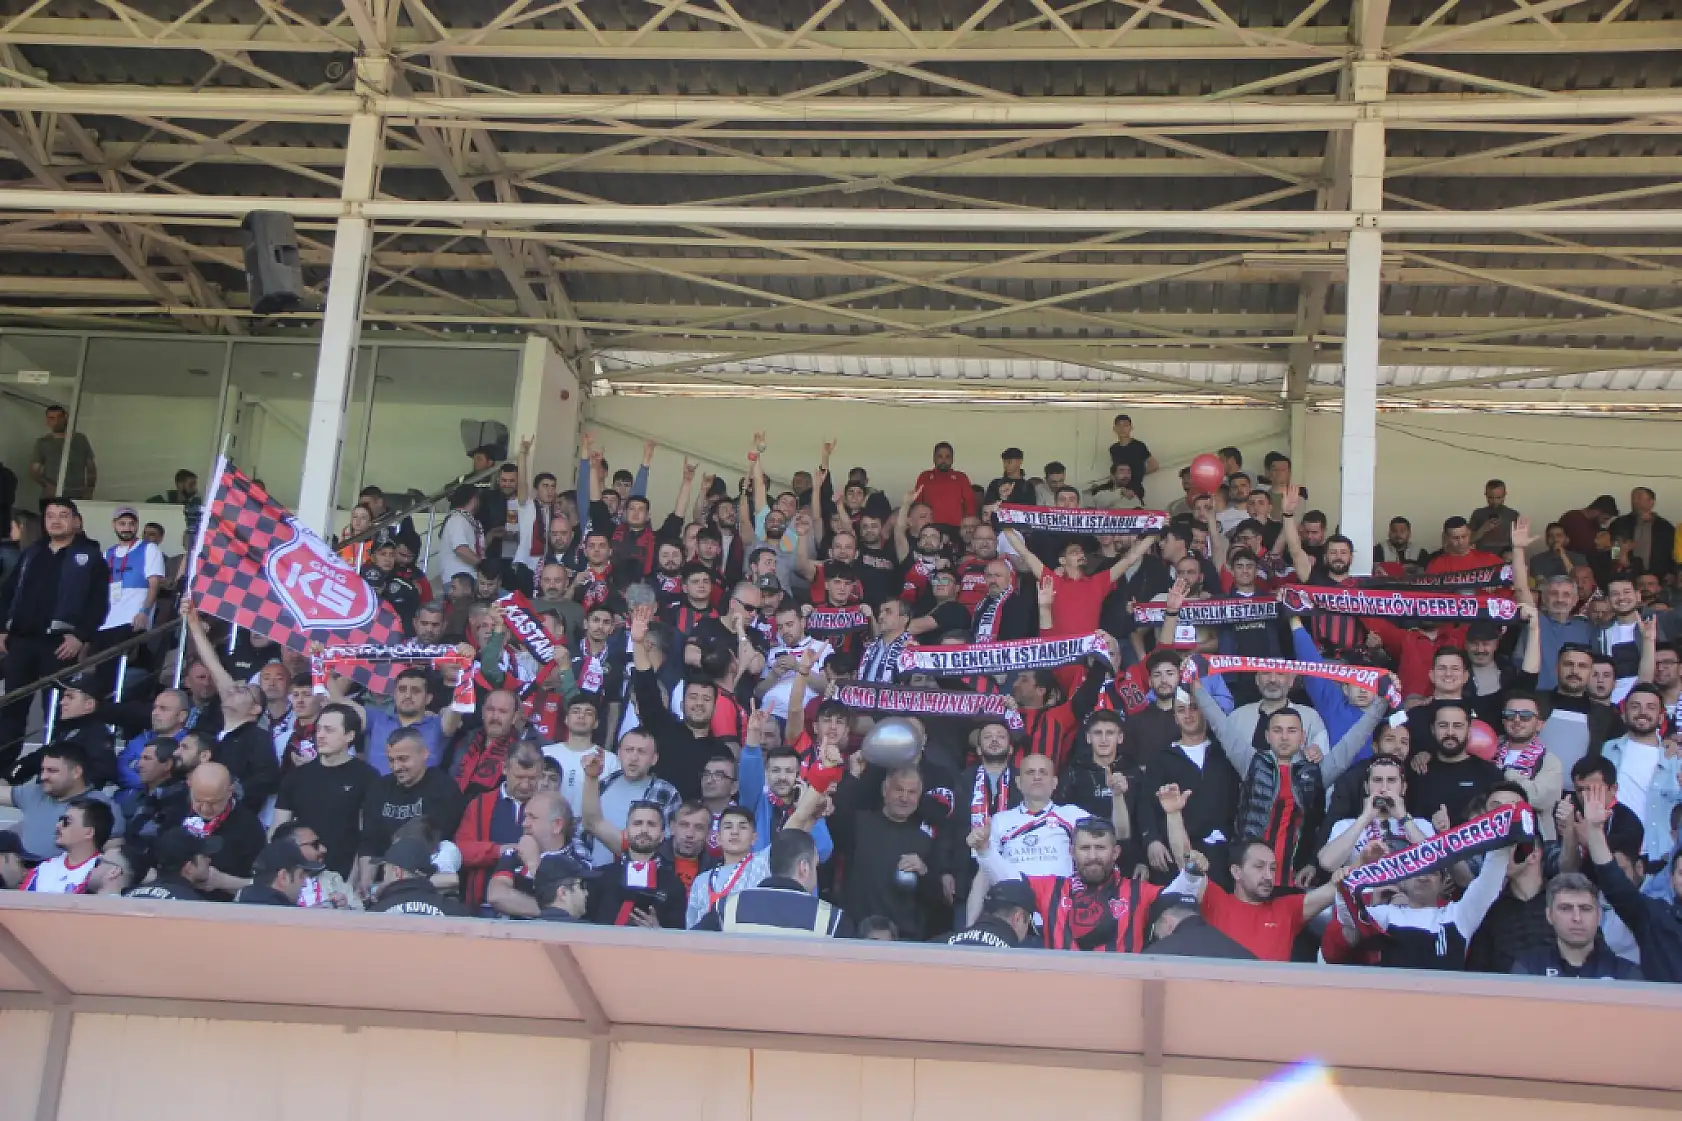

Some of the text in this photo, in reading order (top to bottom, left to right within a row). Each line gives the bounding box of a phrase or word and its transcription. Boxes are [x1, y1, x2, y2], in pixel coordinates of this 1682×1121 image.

[1417, 597, 1457, 617] DERE
[1459, 597, 1478, 617] 37
[1448, 817, 1495, 852] DERE
